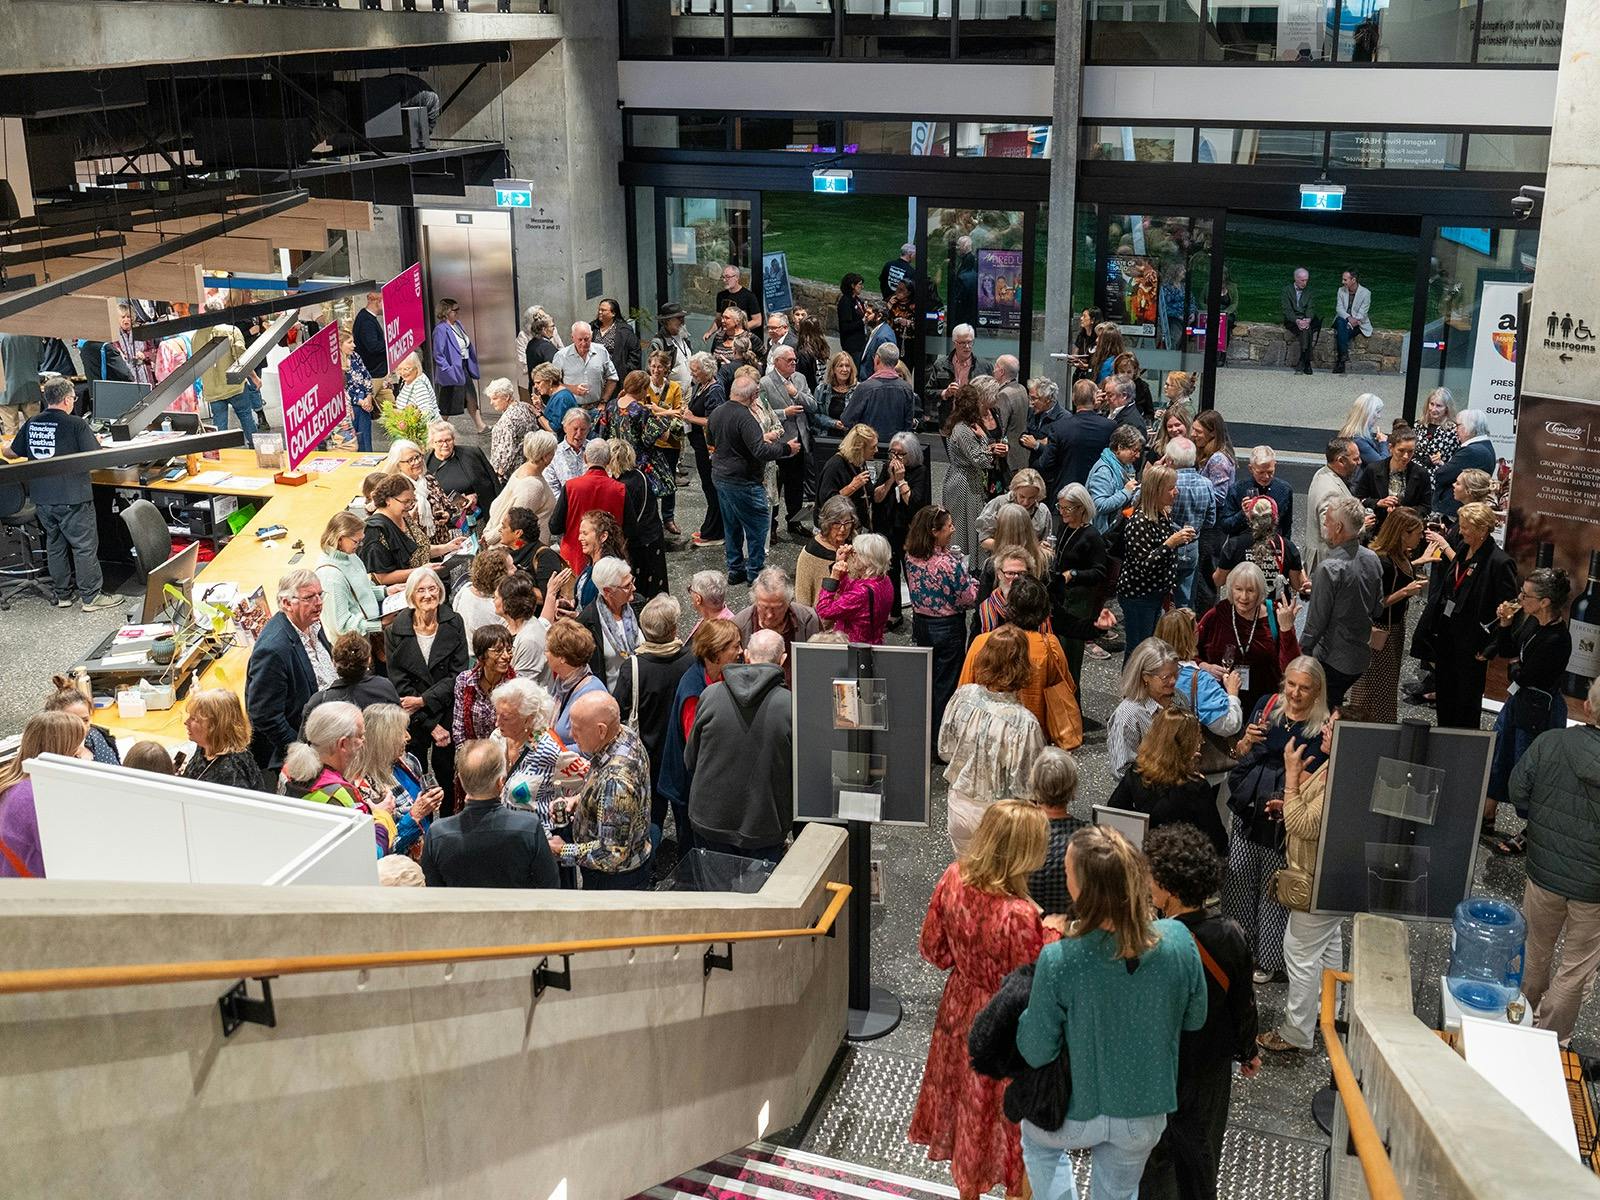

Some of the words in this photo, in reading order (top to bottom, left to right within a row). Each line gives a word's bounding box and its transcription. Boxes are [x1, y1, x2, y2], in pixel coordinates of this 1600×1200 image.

[387, 316, 400, 342] BUY
[389, 328, 414, 364] TICKETS
[1544, 338, 1596, 352] Restrooms
[286, 384, 319, 432] TICKET
[290, 392, 344, 460] COLLECTION
[29, 438, 56, 446] Festival
[1540, 460, 1570, 470] GROWERS
[1536, 473, 1570, 484] MARGARET
[1536, 492, 1572, 502] AUTHENTIC
[1542, 486, 1572, 496] CRAFTERS
[1584, 492, 1597, 500] FINE
